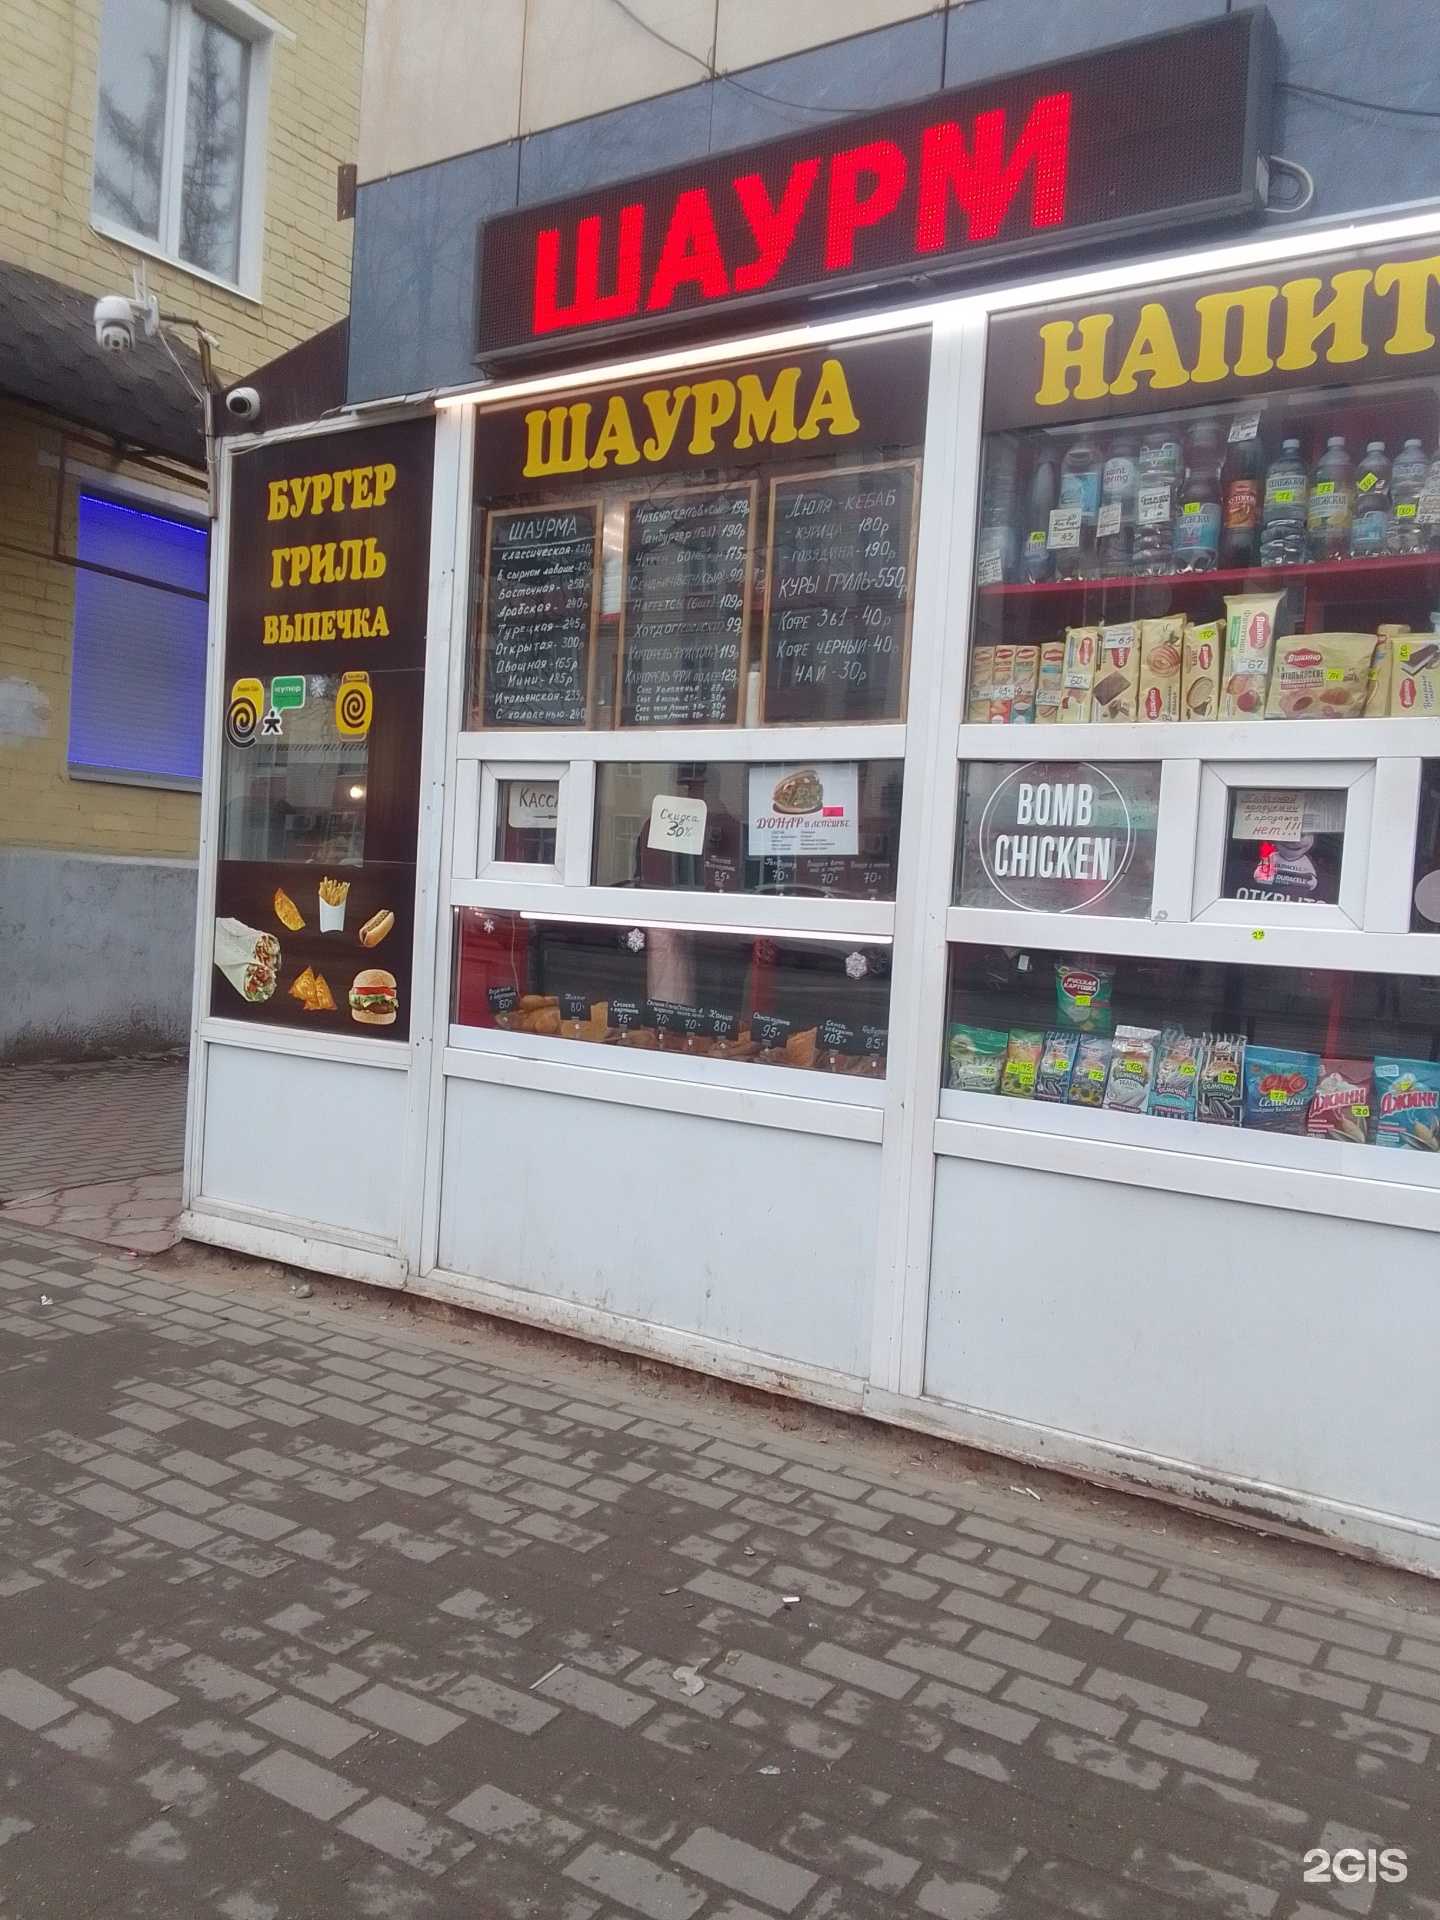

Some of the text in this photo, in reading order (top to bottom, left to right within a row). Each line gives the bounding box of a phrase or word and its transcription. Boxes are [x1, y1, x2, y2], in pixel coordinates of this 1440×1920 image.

[533, 92, 1072, 335] ШАУРМ
[523, 360, 860, 478] ШАУРМА
[267, 463, 397, 521] БУРГЕР
[508, 516, 577, 541] ШАУРМА
[270, 537, 387, 588] ГРИЛЬ
[263, 606, 390, 645] ВЫПЕЧКА
[660, 807, 700, 826] Скидка
[1016, 783, 1093, 827] BOMB
[666, 822, 693, 839] 30%
[994, 834, 1112, 881] CHICKEN
